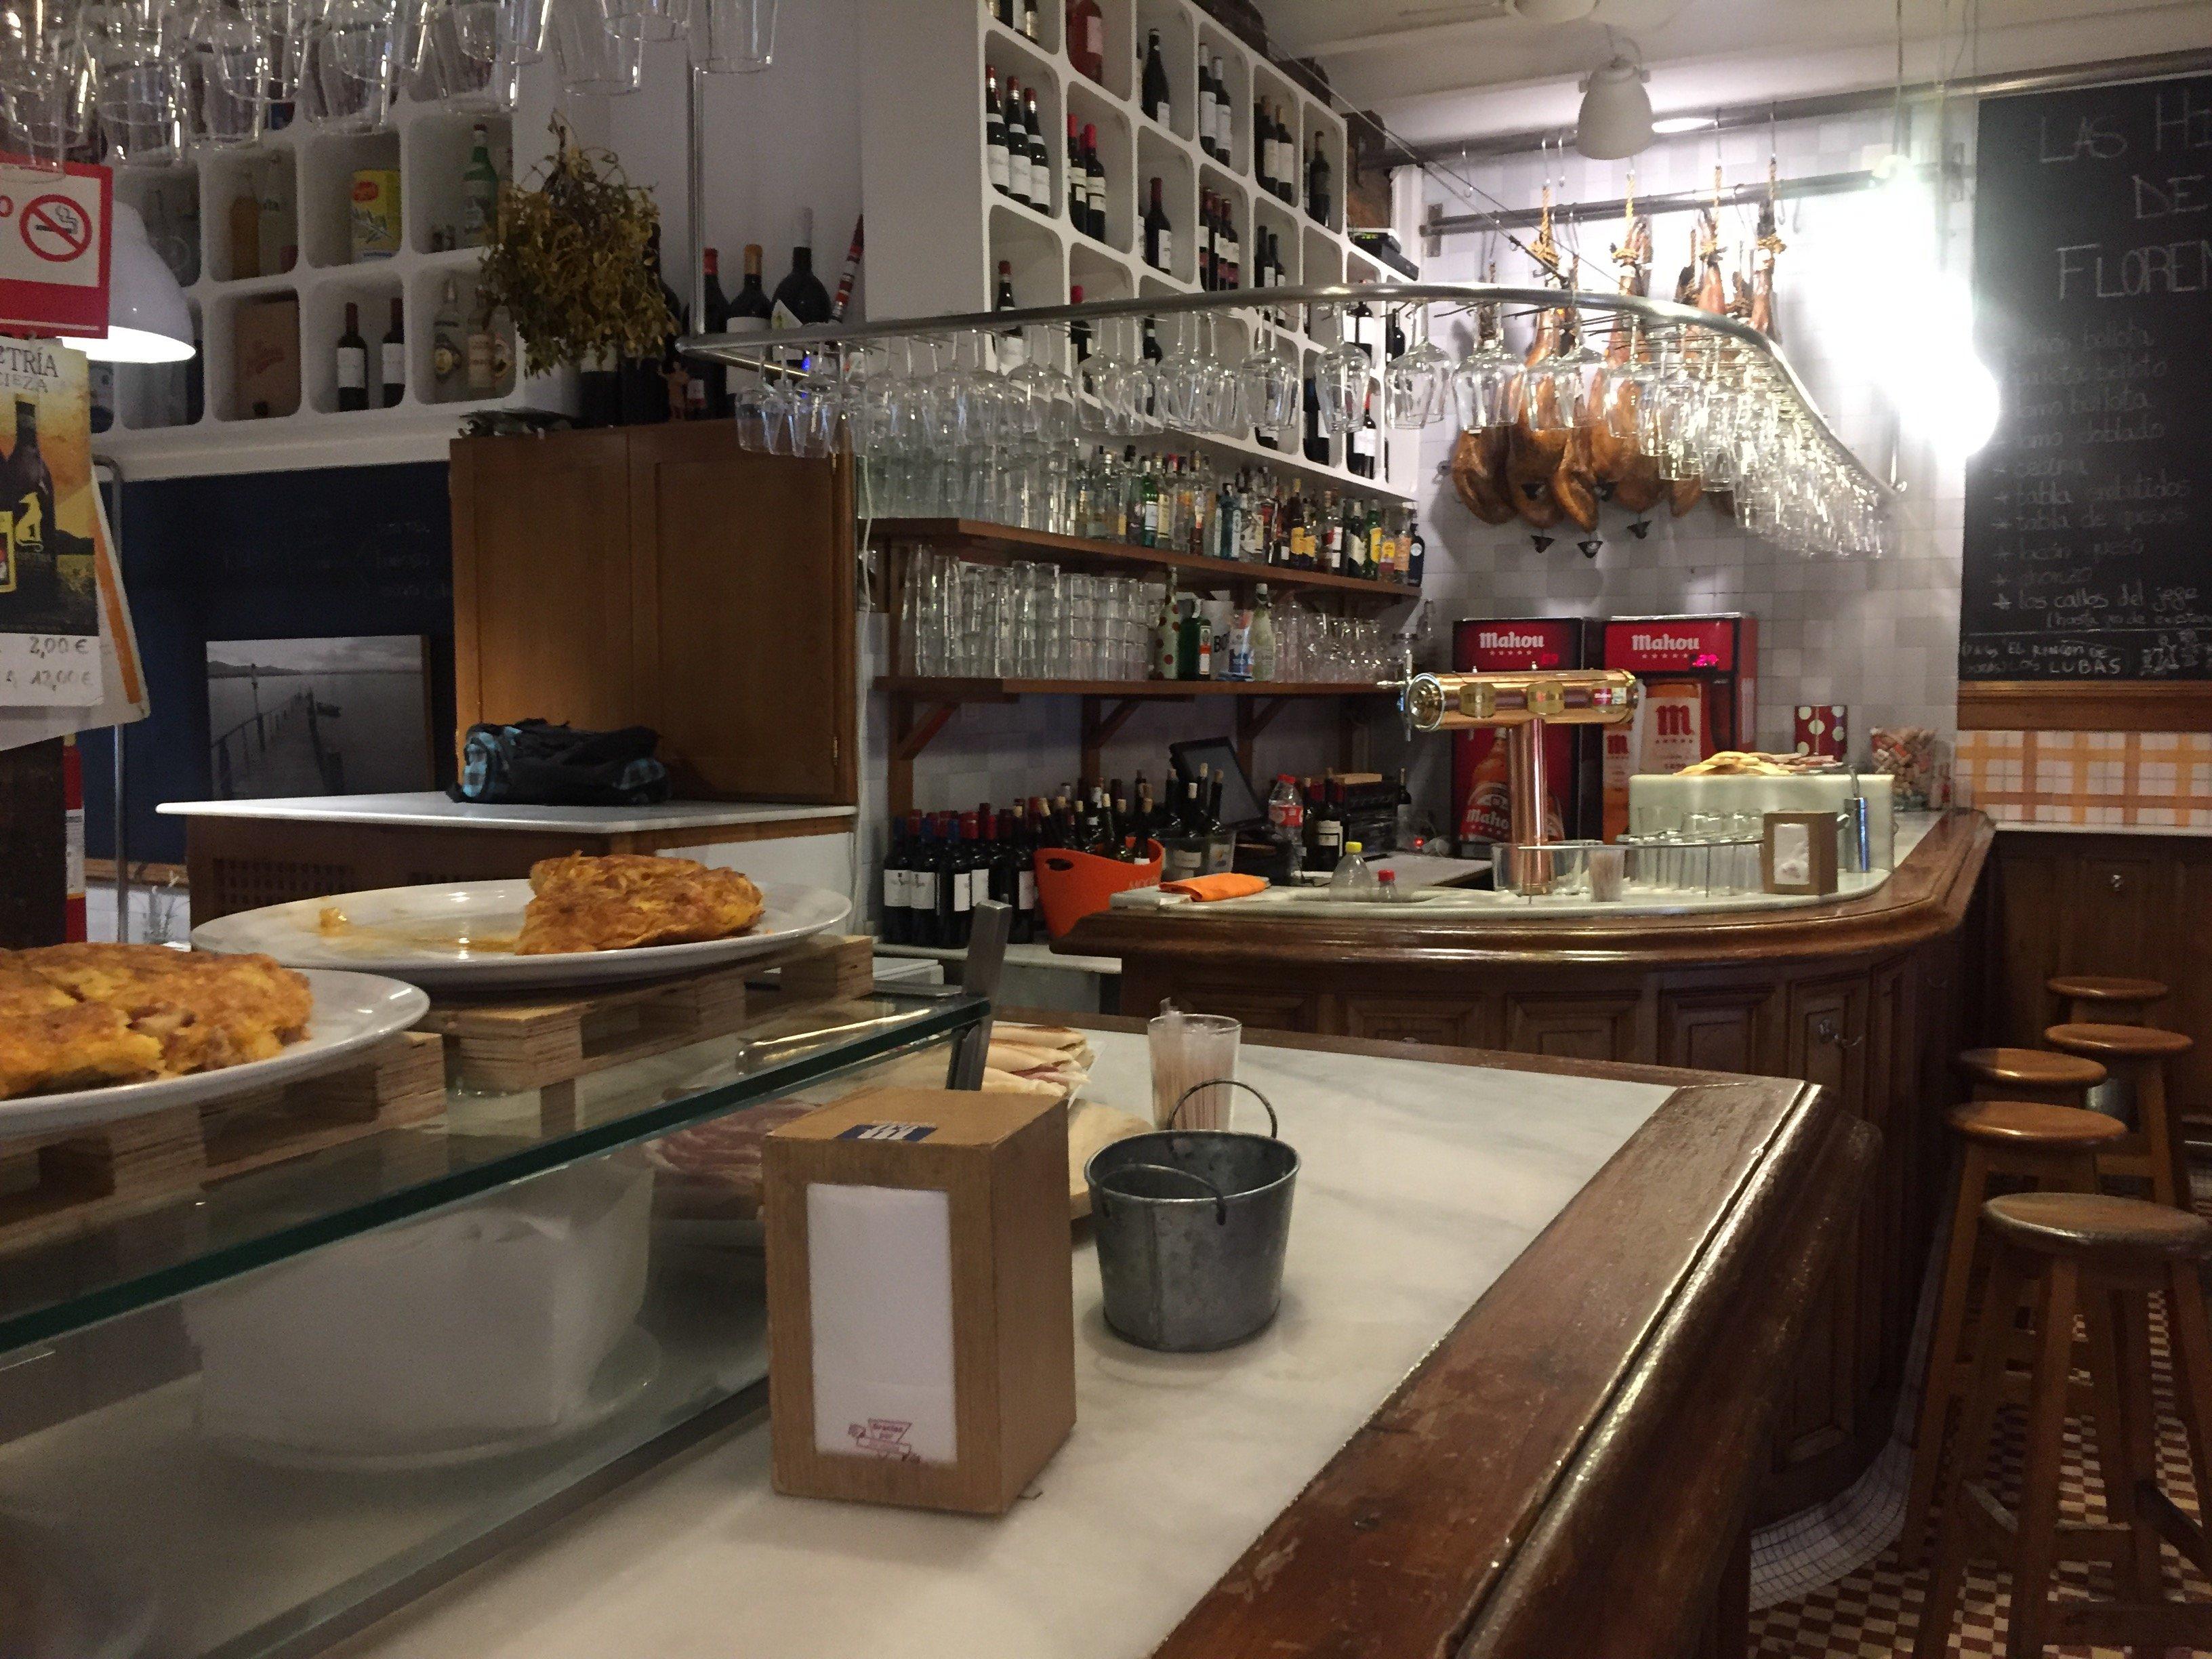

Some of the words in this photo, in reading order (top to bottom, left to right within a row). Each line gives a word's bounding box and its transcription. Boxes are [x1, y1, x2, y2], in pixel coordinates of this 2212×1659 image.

[2131, 174, 2209, 220] DE
[1479, 631, 1545, 649] Mahou
[1631, 633, 1700, 651] Mahou
[1467, 808, 1511, 830] Maho
